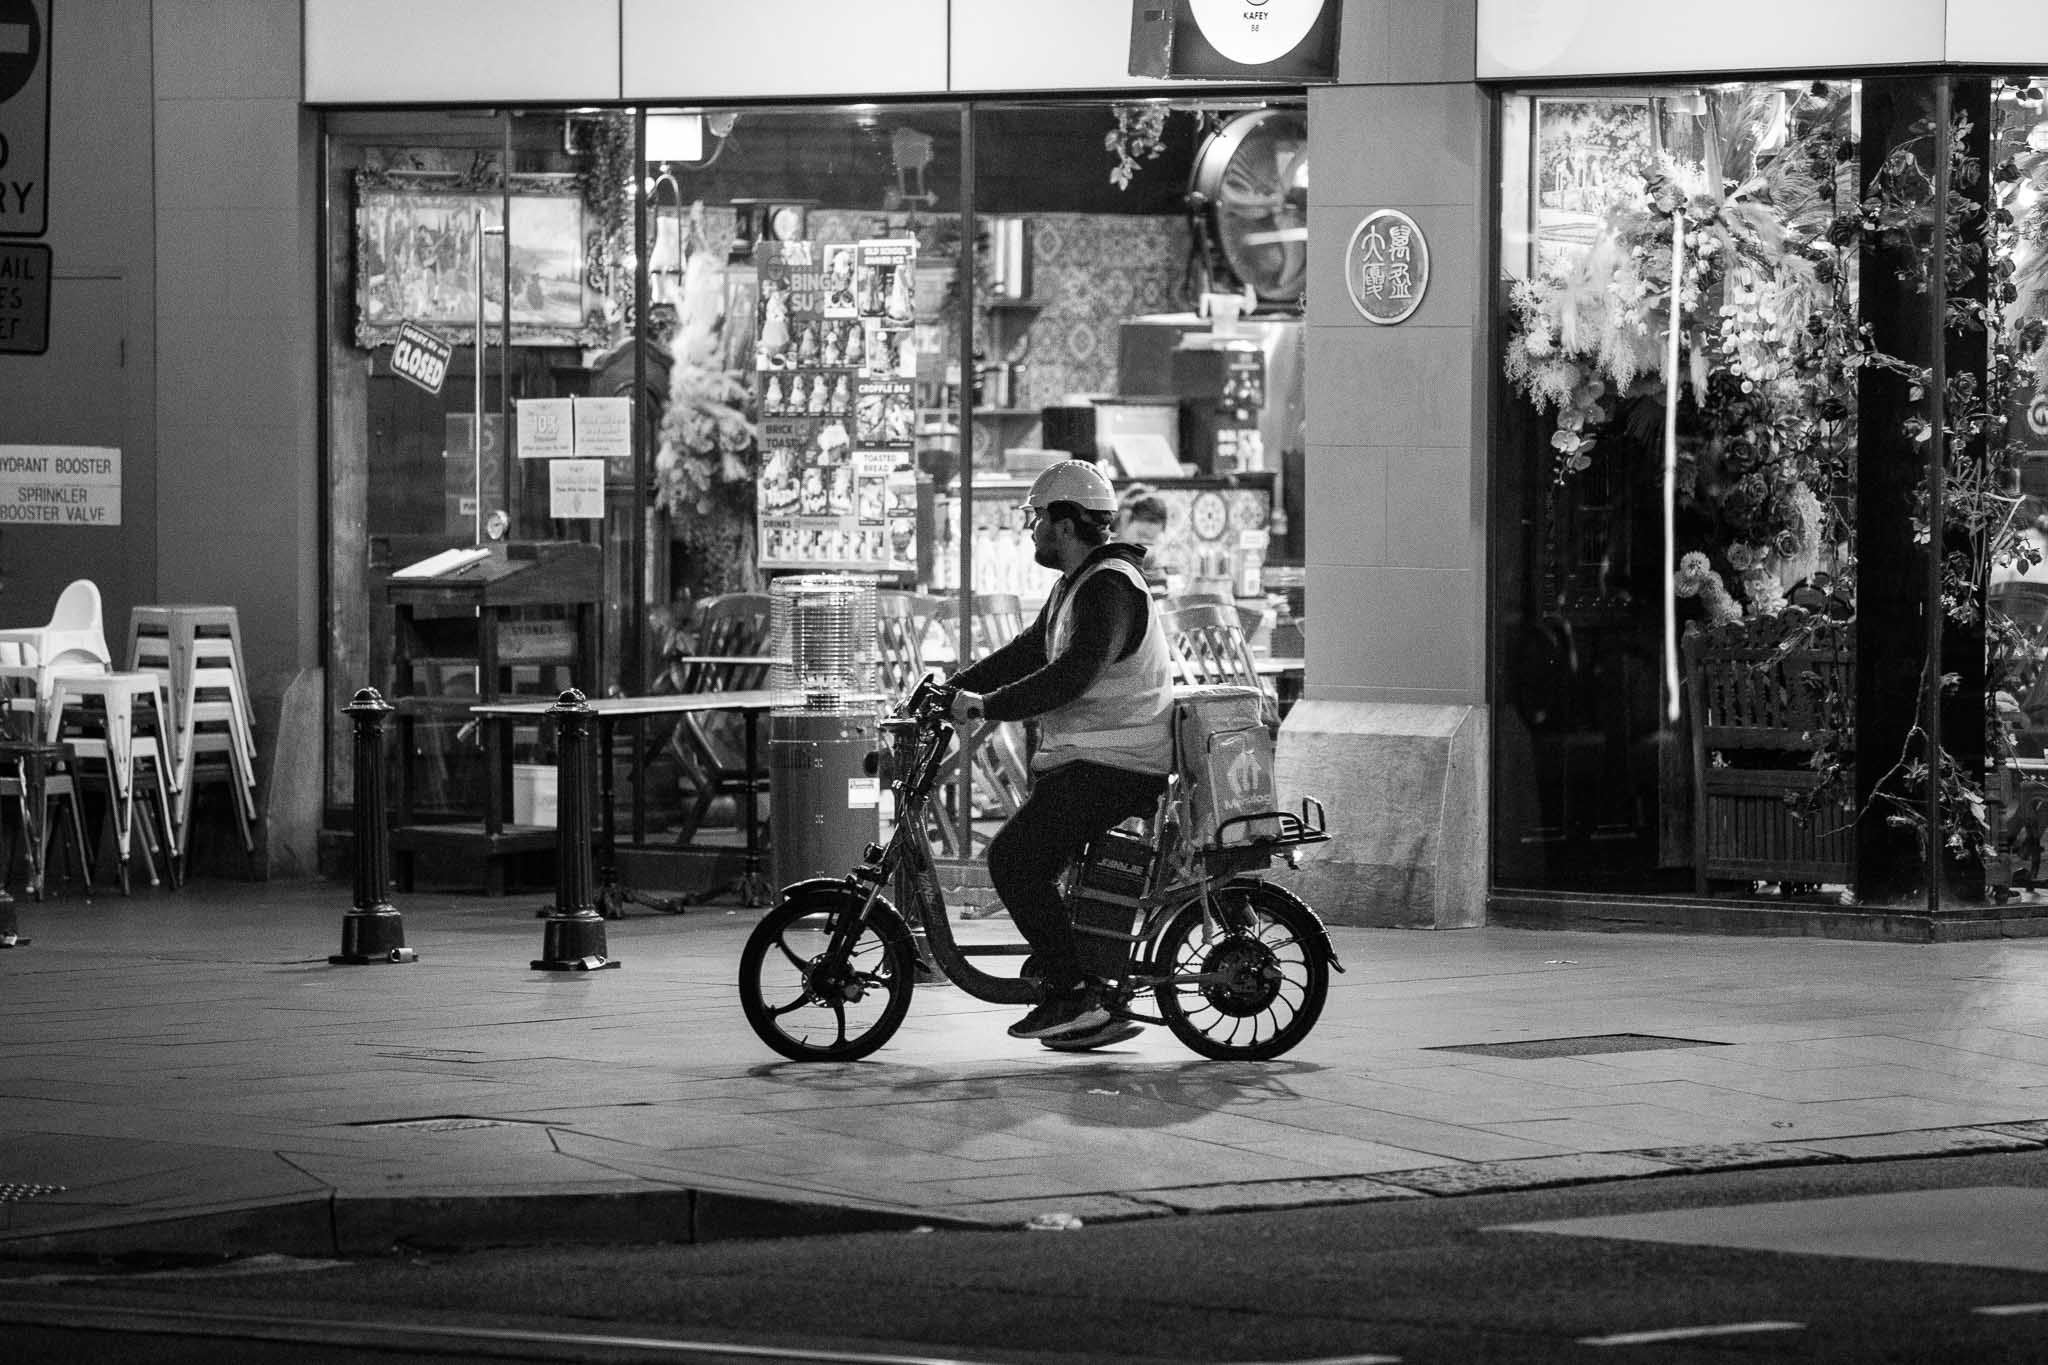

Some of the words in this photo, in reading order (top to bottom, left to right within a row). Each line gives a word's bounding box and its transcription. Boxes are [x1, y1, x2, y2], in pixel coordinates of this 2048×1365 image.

[1243, 11, 1269, 21] KAFEY
[791, 293, 814, 312] SU
[395, 340, 443, 386] CLOSED
[0, 458, 48, 473] YDRANT
[56, 458, 111, 474] BOOSTER
[18, 487, 87, 504] SPRINKLER
